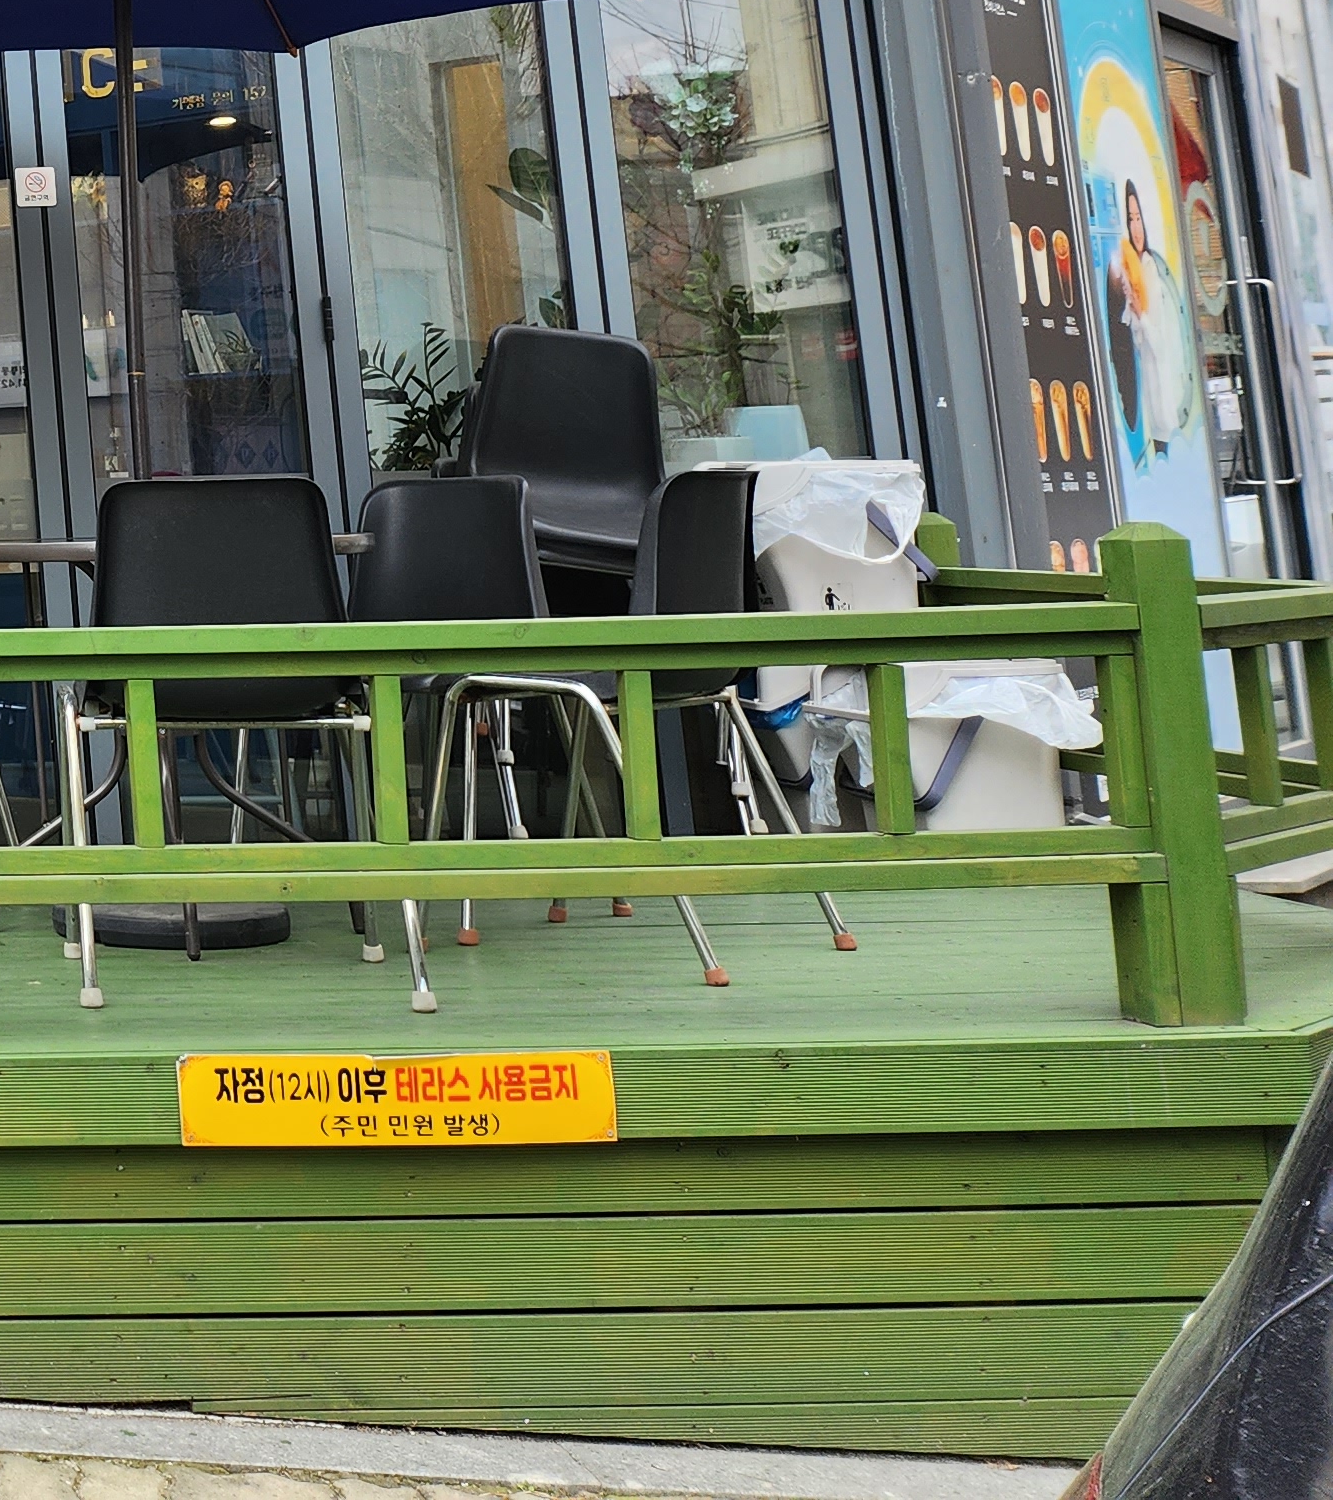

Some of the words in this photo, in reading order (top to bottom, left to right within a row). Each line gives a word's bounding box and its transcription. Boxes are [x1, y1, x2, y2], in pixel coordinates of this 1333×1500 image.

[214, 1066, 330, 1104] 자정(12시)
[337, 1066, 388, 1104] 이후
[394, 1064, 472, 1104] 테라스
[478, 1063, 579, 1102] 사용금지
[319, 1114, 379, 1138] (주민
[388, 1114, 434, 1137] 민원
[443, 1113, 502, 1138] 발생)
